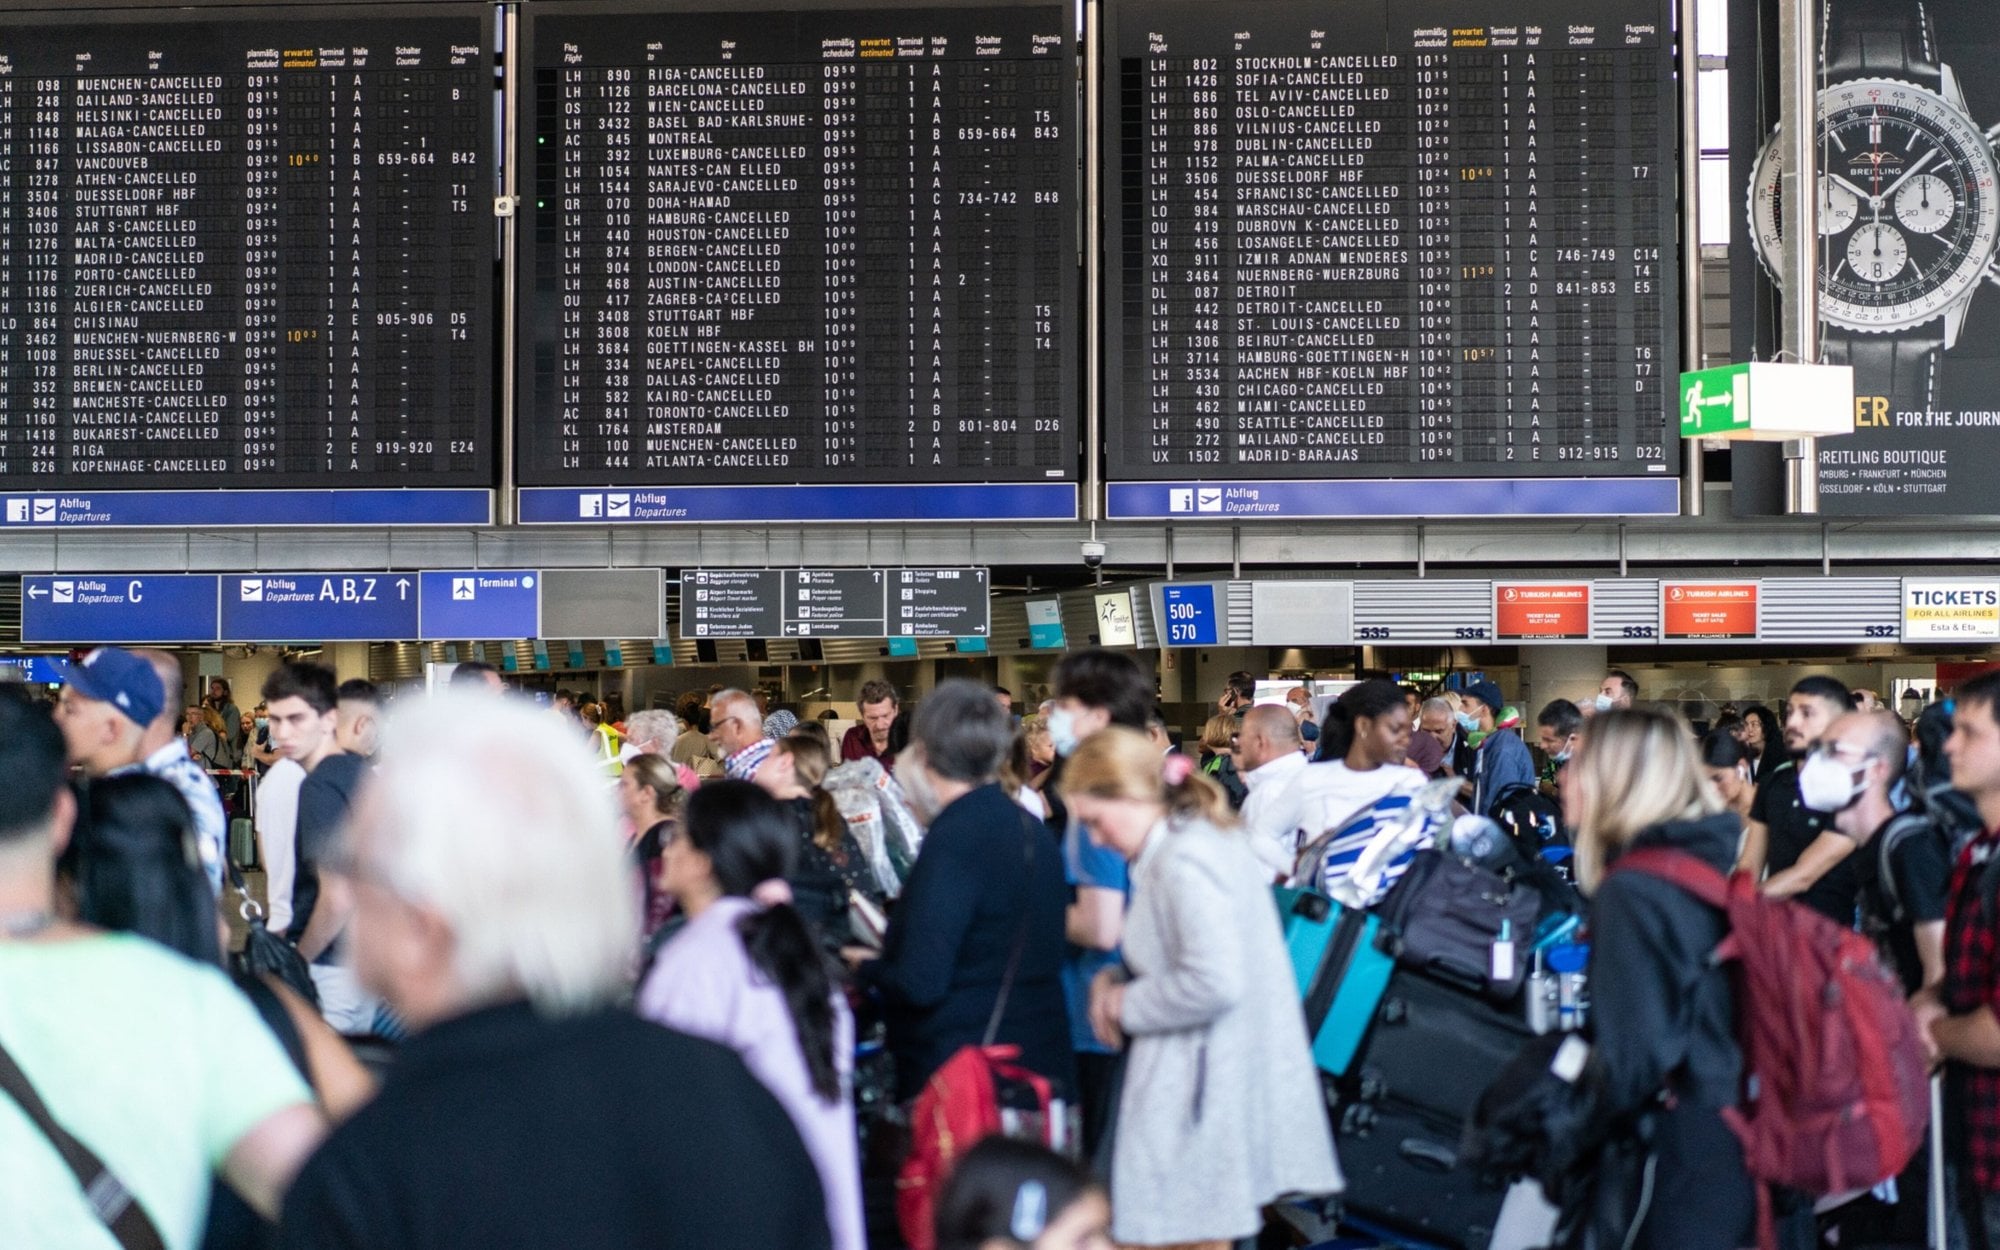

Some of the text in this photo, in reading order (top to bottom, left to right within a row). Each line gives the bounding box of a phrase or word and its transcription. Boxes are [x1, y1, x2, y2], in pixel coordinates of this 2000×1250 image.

[1490, 27, 1517, 35] Terminal
[1568, 25, 1594, 33] Schalter
[1626, 24, 1654, 34] Flugsteig
[1149, 33, 1162, 42] Flug
[1453, 38, 1487, 46] estimated
[1569, 36, 1594, 44] Counter
[1626, 35, 1641, 43] Gate
[1236, 56, 1397, 69] STOCKHOLM-CANCELLED
[649, 67, 763, 80] RIGA-CANCELLED
[78, 77, 221, 90] MUENCHEN-CANCELLED
[649, 83, 805, 96] BARCELONA-CANCELLED
[1236, 88, 1388, 102] TEL AVIV-CANCELLED
[648, 99, 764, 112] WIEN-CANCELLED
[1236, 105, 1354, 118] OSLO-CANCELLED
[77, 109, 221, 122] HELSINKI-CANCELLED
[959, 128, 1016, 139] 659-664
[1035, 127, 1058, 138] B43
[1236, 121, 1380, 134] VILNIUS-CANCELLED
[649, 133, 712, 144] MONTREAL
[77, 140, 221, 153] LISSABON-CANCELLED
[379, 153, 434, 164] 659-664
[453, 152, 475, 163] B42
[649, 147, 805, 160] LUXEMBURG-CANCELLED
[1237, 154, 1363, 166] PALMA-CANCELLED
[76, 172, 196, 185] ATHEN-CANCELLED
[1237, 170, 1363, 183] DUESSELDORF HBF
[649, 179, 797, 192] SARAJEVO-CANCELLED
[76, 188, 195, 201] DUESSELDORF HBF
[960, 192, 1016, 204] 734-742
[1035, 192, 1058, 203] B48
[1237, 186, 1398, 199] SFRANCISC-CANCELLED
[648, 196, 730, 208] DOHA-HAMAD
[157, 205, 179, 215] HBF
[1237, 203, 1389, 215] WARSCHAU-CANCELLED
[649, 212, 789, 224] HAMBURG-CANCELLED
[75, 236, 196, 248] MALTA-CANCELLED
[648, 244, 780, 257] BERGEN-CANCELLED
[1240, 252, 1407, 265] IZMIR ADNAN MENDERES
[649, 260, 780, 273] LONDON-CANCELLED
[75, 268, 195, 280] PORTO-CANCELLED
[1237, 268, 1399, 281] NUERNBERG-WUERZBURG
[75, 284, 211, 296] ZUERICH-CANCELLED
[1238, 286, 1295, 297] DETROIT
[1237, 301, 1382, 314] DETROIT-CANCELLED
[648, 309, 754, 321] STUTTGART HBF
[74, 317, 138, 328] CHISINAU
[648, 326, 720, 337] KOELN HBF
[648, 341, 813, 353] GOETTINGEN-KASSEL BH
[647, 357, 780, 369] NEAPEL-CANCELLED
[74, 364, 203, 376] BERLIN-CANCELLED
[74, 380, 202, 392] BREMEN-CANCELLED
[1238, 383, 1383, 396] CHICAGO-CANCELLED
[647, 390, 771, 402] KAIRO-CANCELLED
[648, 406, 788, 418] TORONTO-CANCELLED
[1239, 416, 1383, 428] SEATTLE-CANCELLED
[1896, 412, 1922, 426] FOR
[1927, 412, 1953, 426] THE
[647, 423, 721, 434] AMSTERDAM
[959, 420, 1016, 431] 801-804
[1036, 420, 1059, 431] D26
[73, 428, 218, 440] BUKAREST-CANCELLED
[1239, 433, 1383, 444] MAILAND-CANCELLED
[376, 442, 432, 453] 919-920
[451, 441, 473, 452] E24
[647, 438, 796, 451] MUENCHEN-CANCELLED
[1239, 449, 1358, 461] MADRID-BARAJAS
[1559, 447, 1617, 458] 912-915
[1637, 447, 1661, 458] D22
[1884, 450, 1946, 464] BOUTIQUE
[73, 460, 226, 472] KOPENHAGE-CANCELLED
[647, 455, 788, 467] ATLANTA-CANCELLED
[1820, 468, 1946, 478] AMBURG FRANKFURT MÜNCHEN
[1226, 488, 1259, 500] Abflug
[1820, 483, 1947, 493] ÜSSELDORF KÖLN STUTTGART
[60, 498, 90, 510] Abflug
[635, 494, 666, 505] Abflug
[635, 507, 687, 518] Departures
[1226, 502, 1280, 513] Departures
[60, 511, 111, 523] Departures
[78, 581, 106, 592] Abflug
[266, 580, 295, 591] Abflug
[479, 578, 517, 587] Terminal
[129, 581, 142, 602] C
[319, 578, 376, 603] A,B,Z
[78, 594, 124, 604] Departures
[266, 592, 314, 602] Departures
[1912, 591, 1996, 605] TICKETS
[1170, 603, 1202, 620] 500-
[1953, 609, 1993, 617] AIRLINES
[1172, 624, 1196, 640] 570
[1361, 627, 1389, 639] 535
[1456, 628, 1485, 639] 534
[1623, 626, 1652, 638] 533
[1866, 626, 1894, 637] 532
[1931, 623, 1950, 632] Esta
[1962, 623, 1976, 631] Eta
